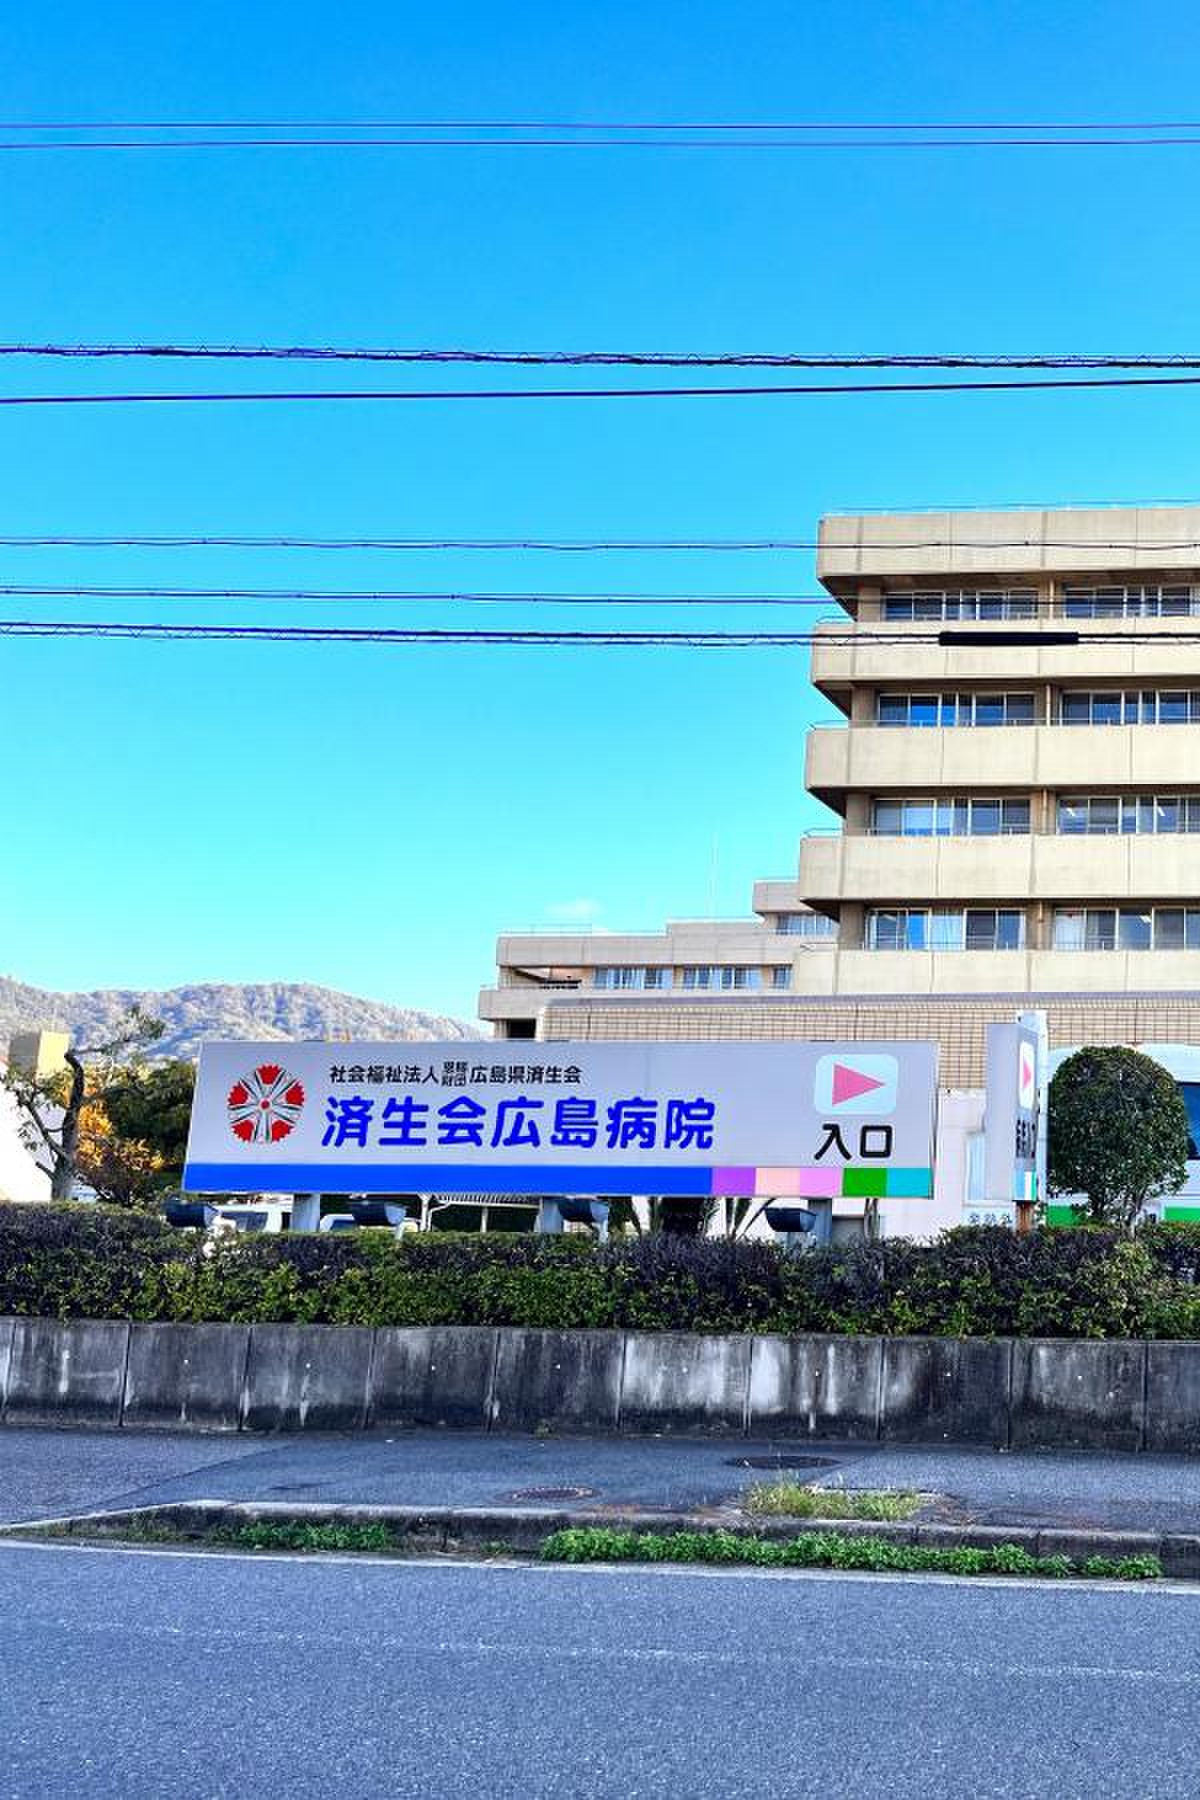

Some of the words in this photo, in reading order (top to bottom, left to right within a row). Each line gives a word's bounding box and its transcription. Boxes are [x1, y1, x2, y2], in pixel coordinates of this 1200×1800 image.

[321, 1095, 716, 1150] 済生会広島病院
[813, 1123, 893, 1160] 入口
